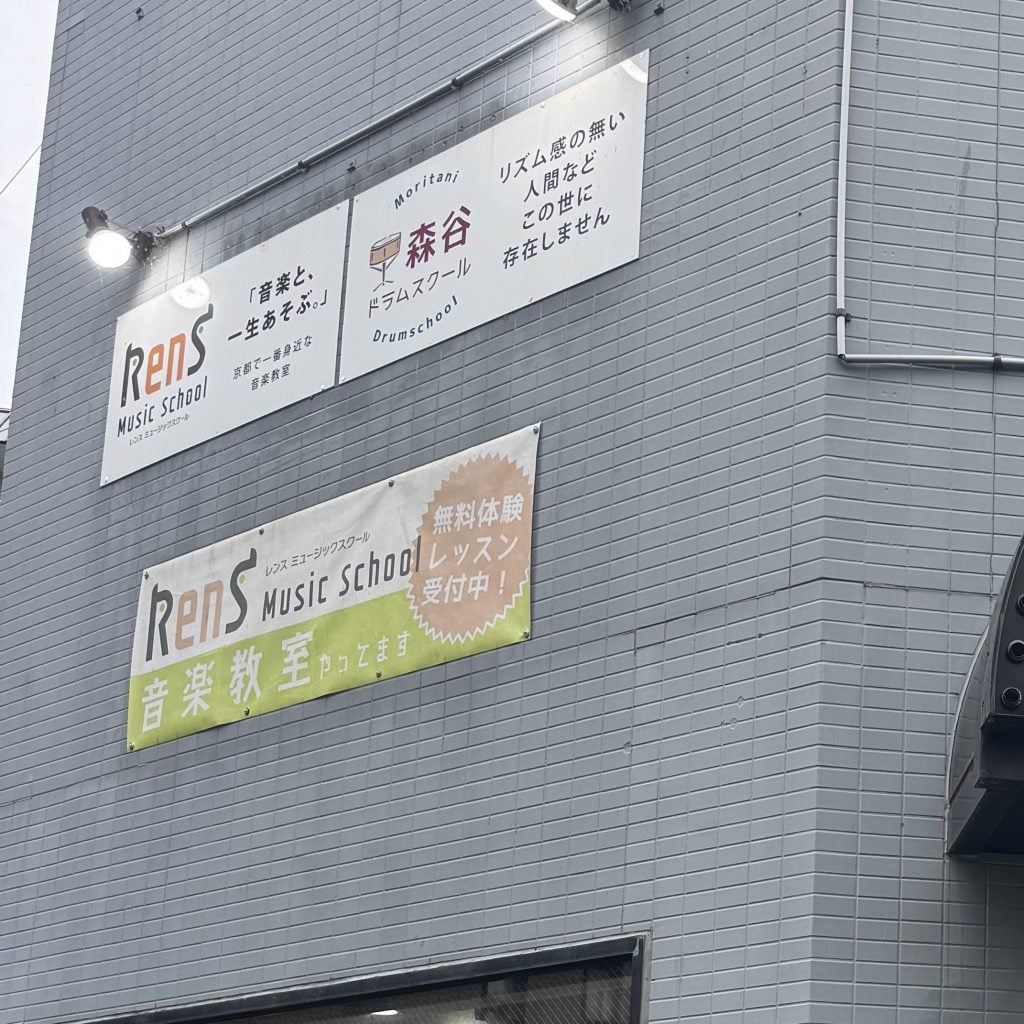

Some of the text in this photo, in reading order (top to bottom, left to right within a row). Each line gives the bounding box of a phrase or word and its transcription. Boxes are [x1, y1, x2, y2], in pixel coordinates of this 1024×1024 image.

[500, 111, 626, 184] リズム感の無い
[394, 170, 460, 210] Moritani
[523, 149, 598, 203] 人間など
[522, 184, 593, 230] この世に
[405, 205, 472, 269] 森谷
[502, 207, 611, 270] 存在しません
[249, 265, 314, 305] 「音楽と、
[369, 257, 472, 319] ドラムスクール
[228, 289, 328, 341] 一生あそぶ。」
[373, 295, 458, 343] Drumschool
[233, 335, 313, 380] 京都で一番身近な
[251, 363, 291, 391] 音楽教室
[160, 375, 208, 417] School
[432, 493, 526, 537] 無料体験
[291, 531, 371, 567] ミュージックスクール
[338, 535, 422, 597] School
[428, 534, 520, 571] レッスン
